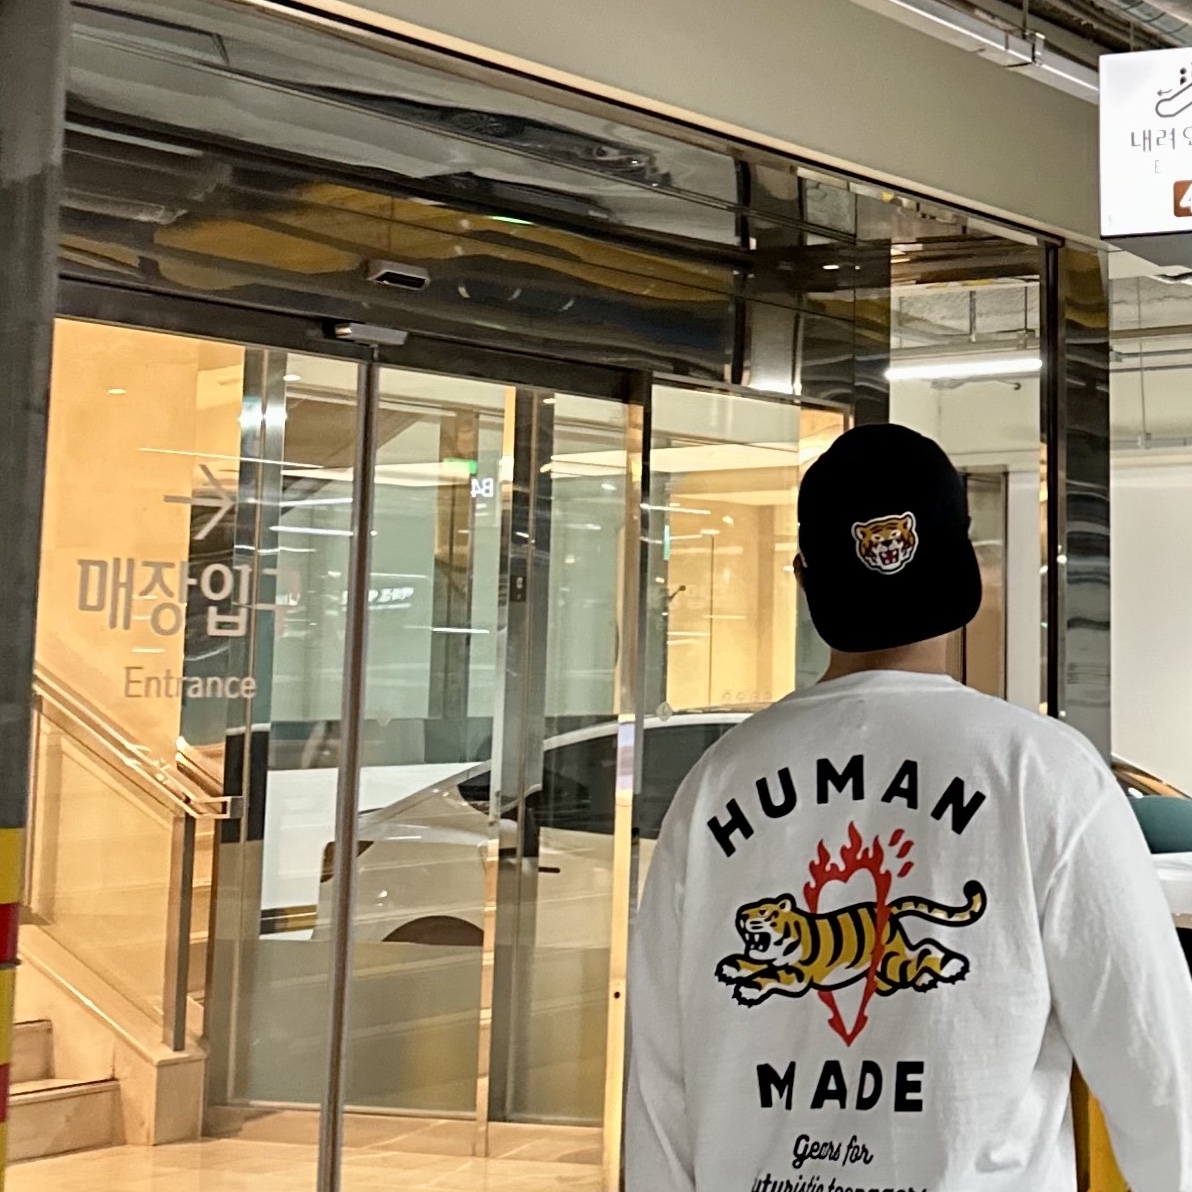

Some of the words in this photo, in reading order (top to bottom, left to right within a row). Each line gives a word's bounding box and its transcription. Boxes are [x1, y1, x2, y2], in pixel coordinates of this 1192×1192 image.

[123, 665, 257, 699] Entrance
[706, 754, 986, 858] HUMAN
[756, 1060, 925, 1113] MADE
[842, 1134, 874, 1167] for
